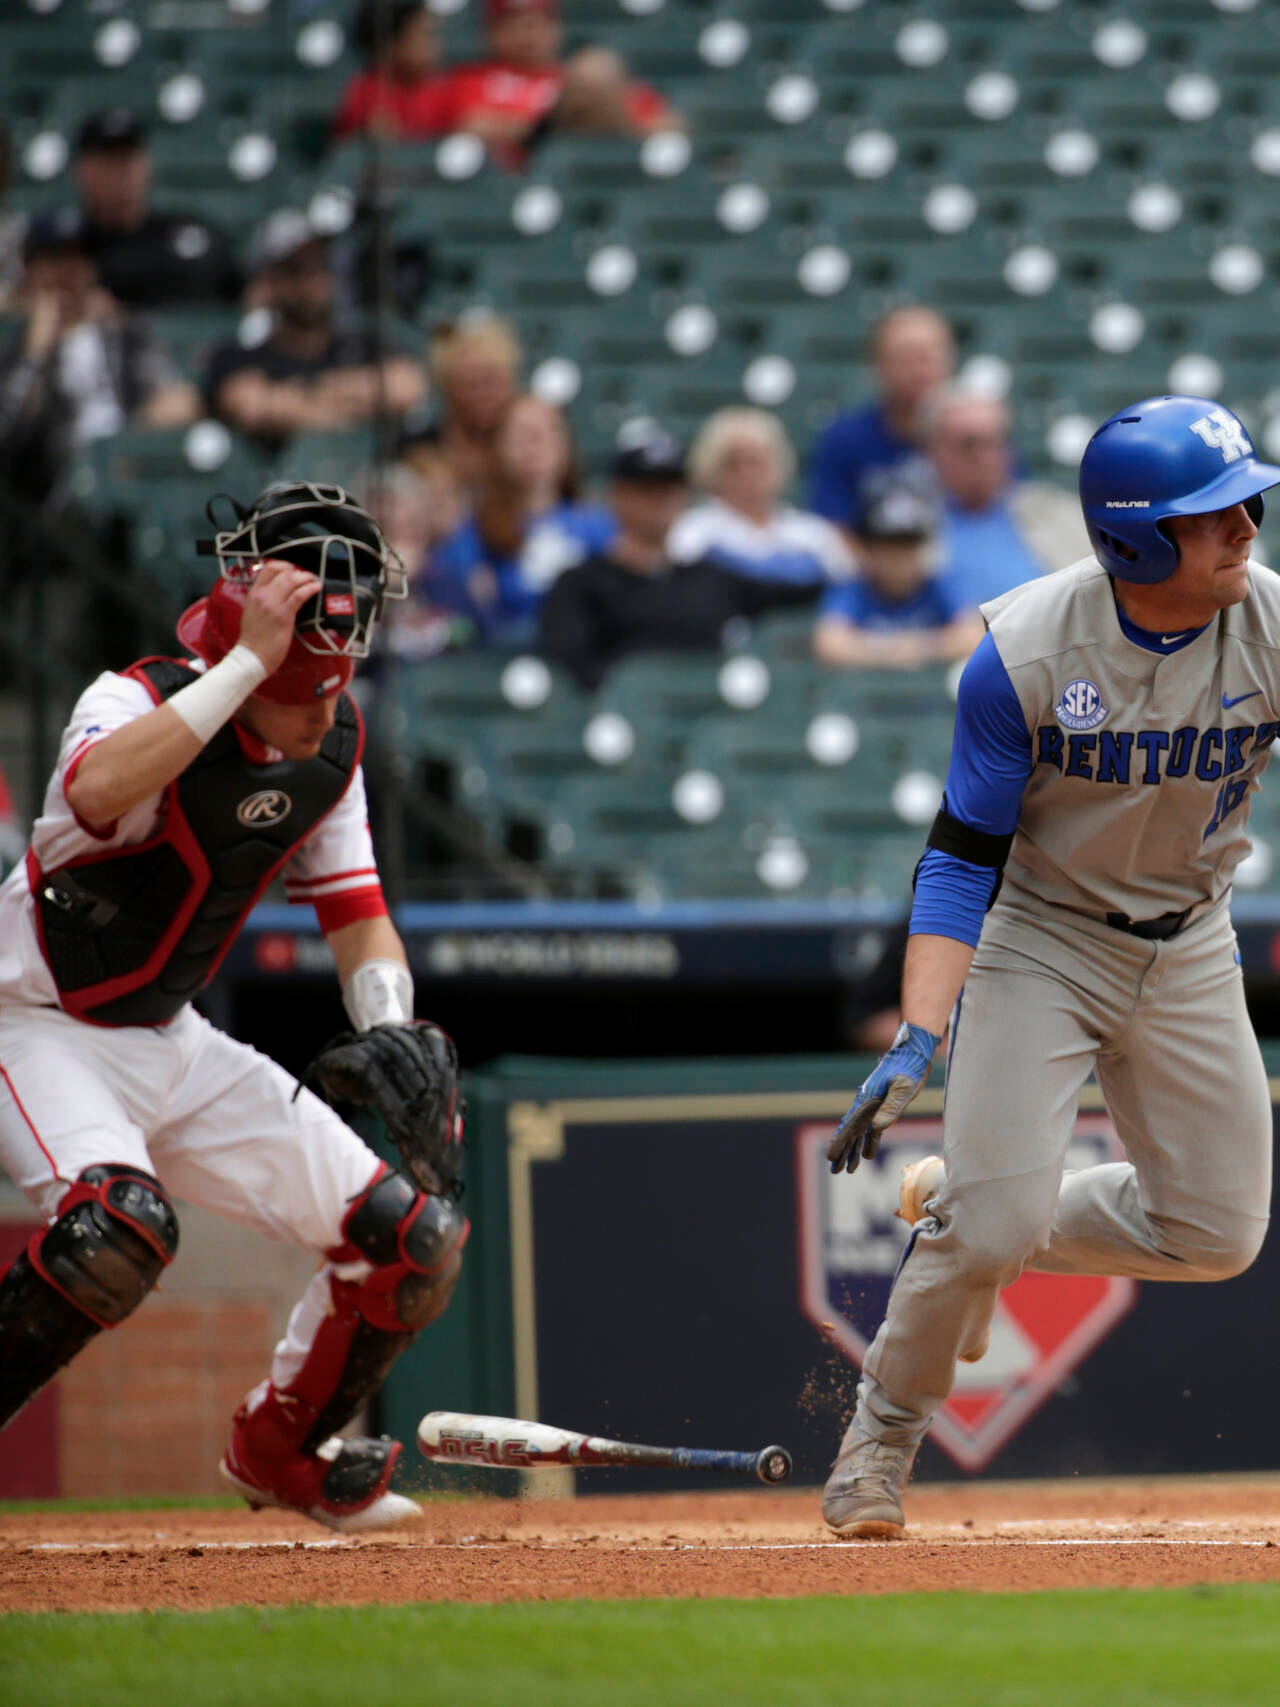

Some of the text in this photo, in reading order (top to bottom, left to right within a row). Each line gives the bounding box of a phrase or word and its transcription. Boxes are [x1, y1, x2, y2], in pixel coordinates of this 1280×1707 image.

[1189, 408, 1253, 464] UK
[1105, 500, 1151, 509] RAWLINGS
[1064, 682, 1097, 717] SEC
